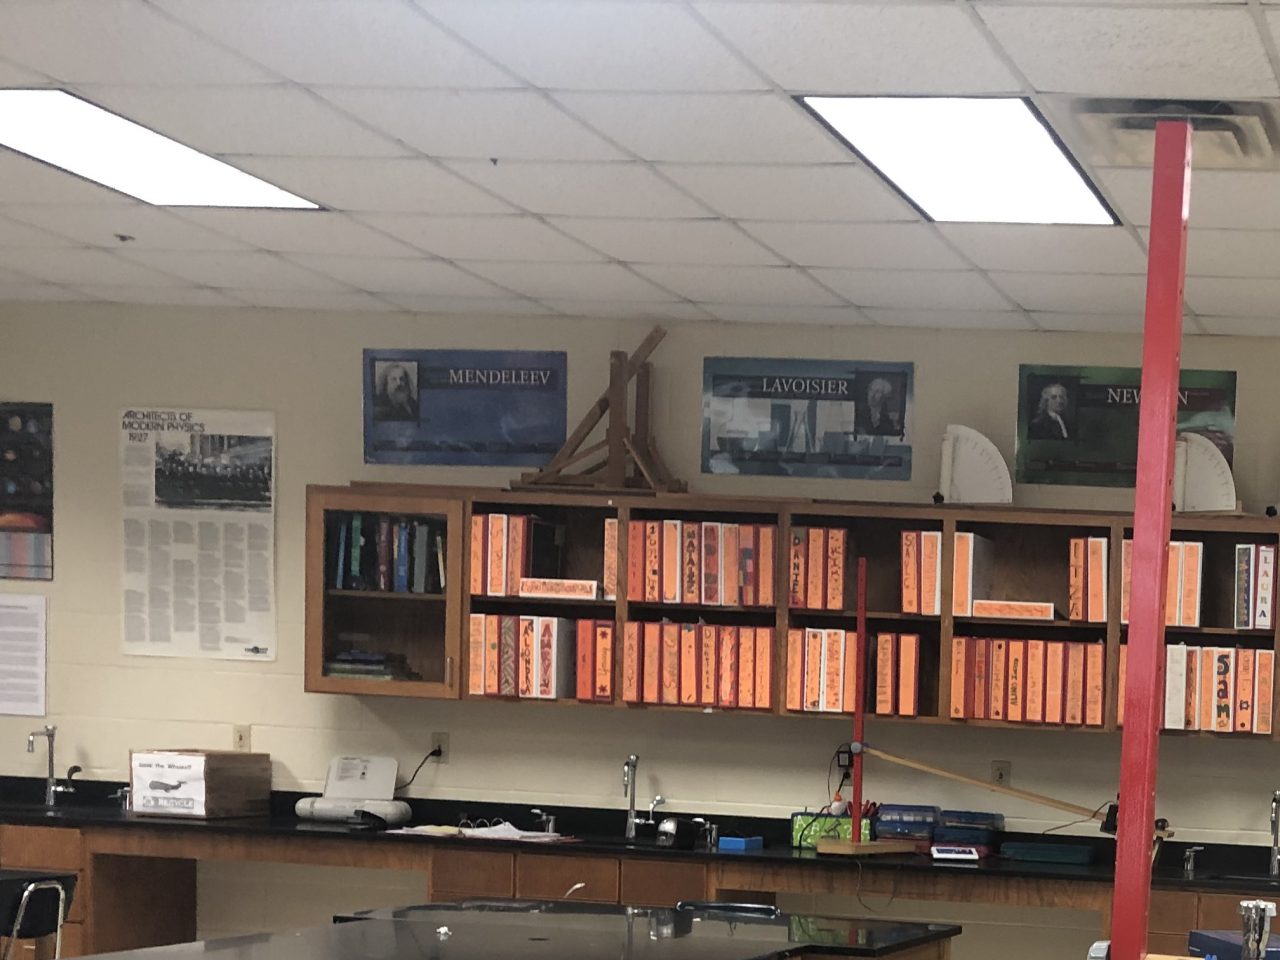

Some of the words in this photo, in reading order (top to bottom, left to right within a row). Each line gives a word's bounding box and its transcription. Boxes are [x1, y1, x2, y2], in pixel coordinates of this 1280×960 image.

[449, 368, 551, 385] MENDELEEV
[761, 377, 849, 395] LAVOISIER
[122, 410, 177, 421] ARCHITECTS
[179, 411, 193, 421] OF
[122, 420, 165, 431] MODERN
[167, 422, 205, 432] PHYSICS
[1259, 556, 1270, 618] LAURA
